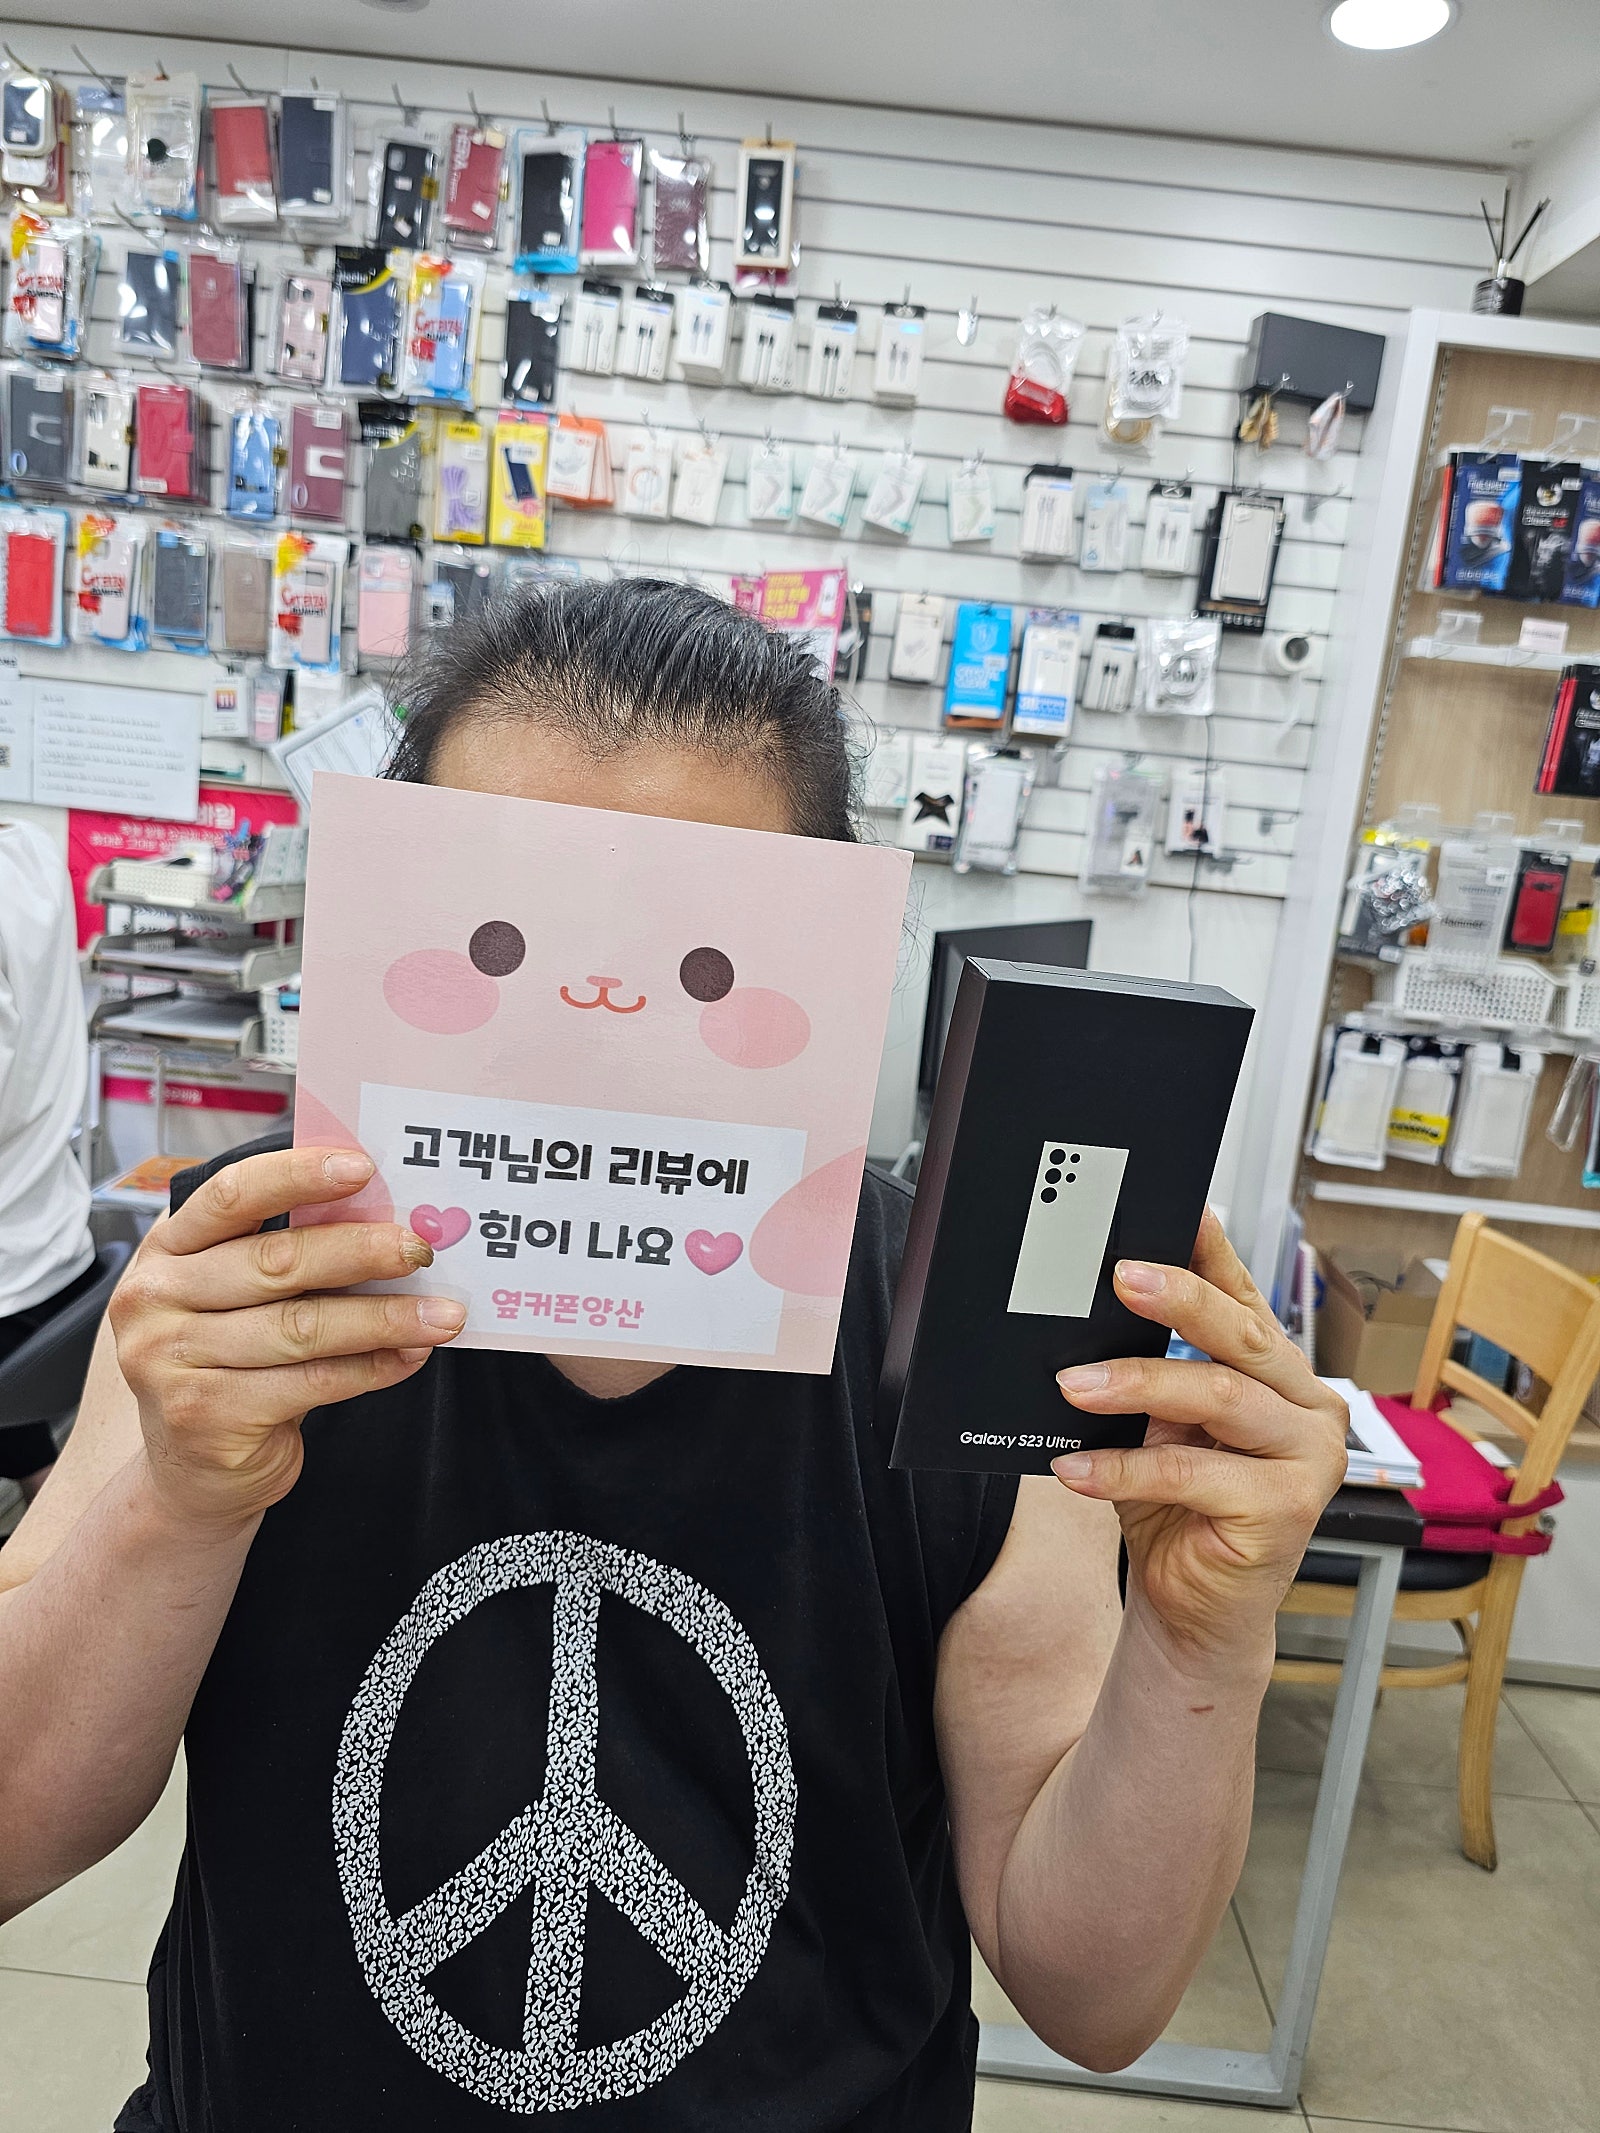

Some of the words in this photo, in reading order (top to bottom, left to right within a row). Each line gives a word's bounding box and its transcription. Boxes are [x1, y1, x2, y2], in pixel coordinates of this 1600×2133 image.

[402, 1124, 592, 1185] 고객님의
[608, 1146, 749, 1195] 리뷰에
[479, 1209, 571, 1259] 힘이
[587, 1224, 674, 1266] 나요
[491, 1288, 645, 1330] 옆커폰양산
[960, 1431, 1017, 1448] Galaxy
[1017, 1434, 1044, 1448] S23
[1045, 1436, 1082, 1449] Ultra
